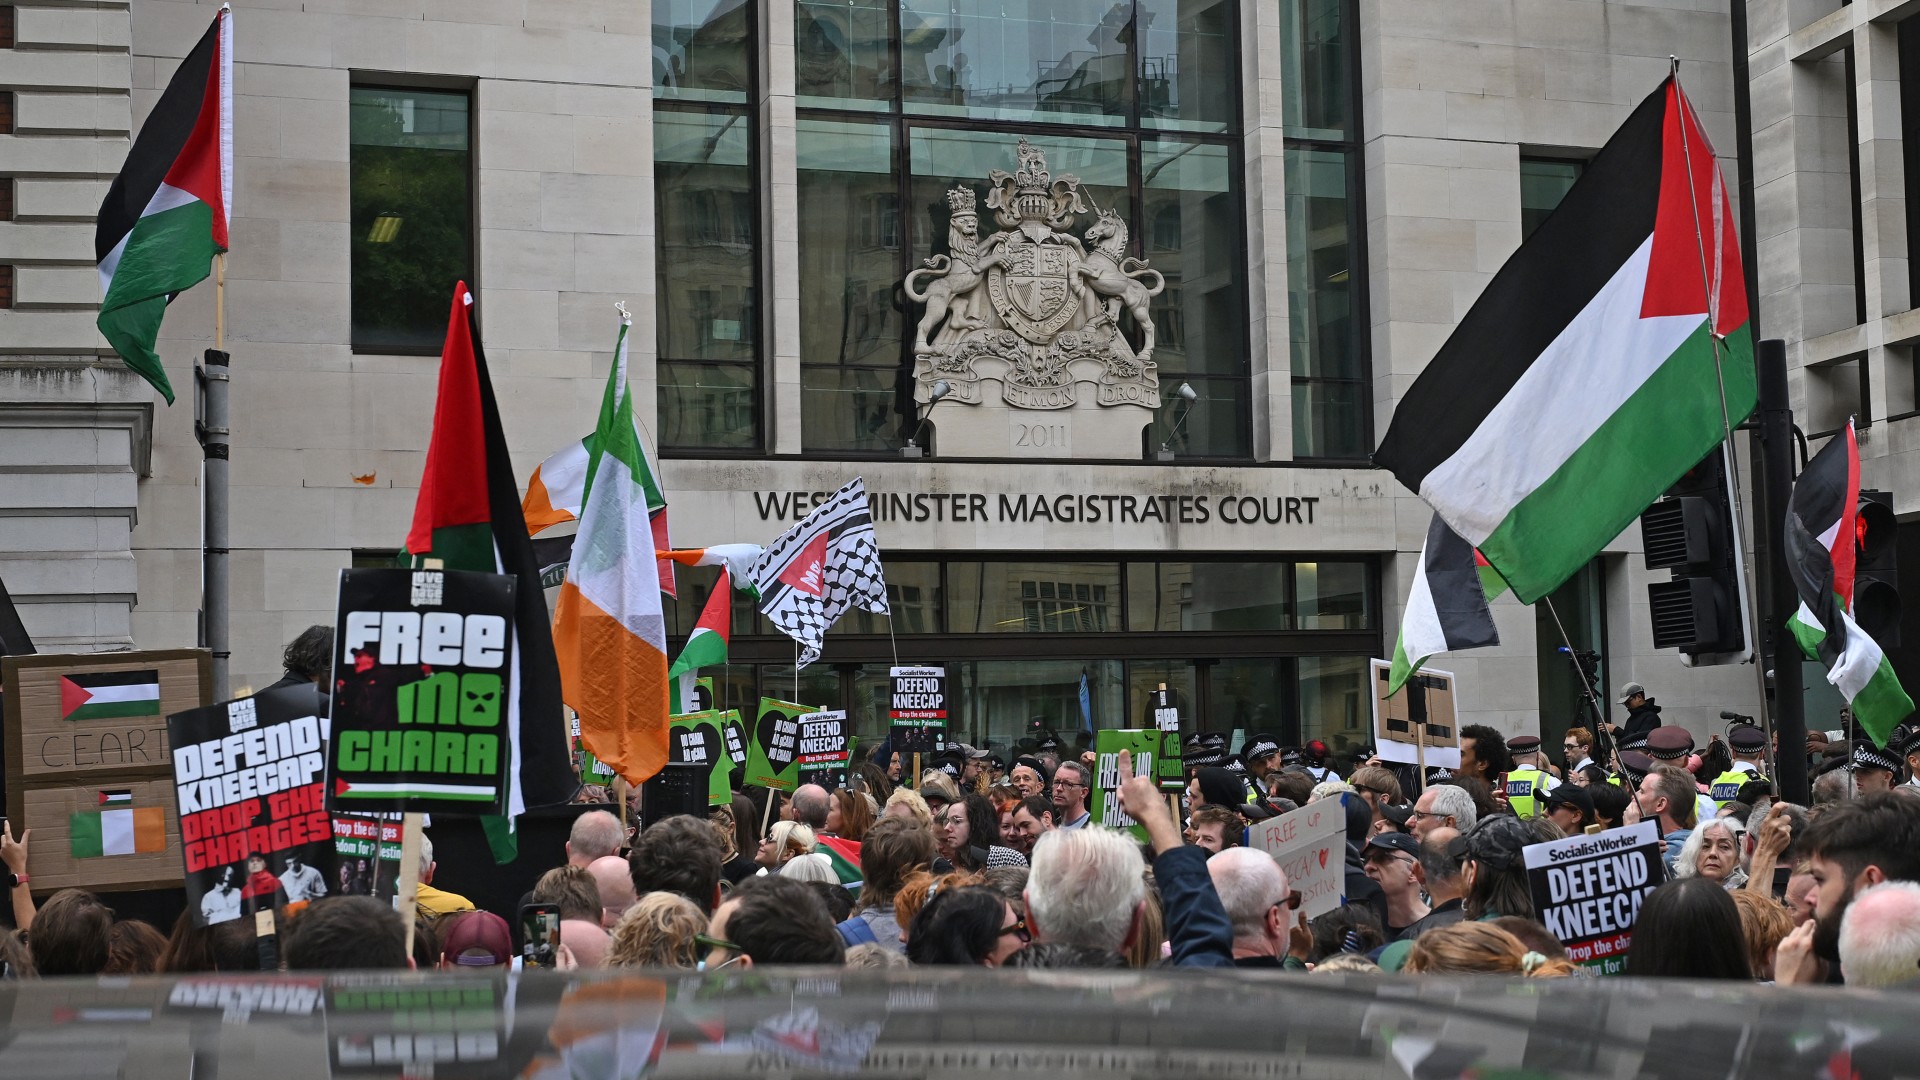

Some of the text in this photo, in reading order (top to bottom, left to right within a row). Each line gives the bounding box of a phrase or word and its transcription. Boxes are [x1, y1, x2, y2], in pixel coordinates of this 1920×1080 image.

[1103, 386, 1157, 406] DROIT
[1015, 423, 1066, 448] 2011
[999, 494, 1210, 524] MAGISTRATES
[1218, 496, 1319, 524] COURT
[896, 678, 939, 693] DEFEND
[893, 693, 944, 709] KNEECAP
[805, 714, 823, 722] Socialist
[894, 719, 913, 727] Freedom
[921, 719, 943, 727] Palestine
[919, 711, 937, 719] charges
[803, 721, 841, 738] DEFEND
[173, 715, 321, 785] DEFEND
[337, 730, 499, 775] CHARA
[800, 736, 845, 754] KNEECAP
[823, 753, 840, 761] charges
[825, 760, 845, 768] Palestine
[177, 751, 324, 816] KNEECAP
[1506, 783, 1530, 794] OLICE
[1711, 786, 1738, 798] POLICE
[181, 798, 262, 844] DROP
[353, 822, 367, 836] the
[1265, 812, 1321, 851] FREE UP
[185, 811, 332, 873] CHARGES
[358, 840, 370, 855] for
[1549, 835, 1638, 862] Socialist Worker
[1547, 851, 1648, 904] DEFEND
[1594, 939, 1613, 955] the
[1604, 959, 1620, 974] for
